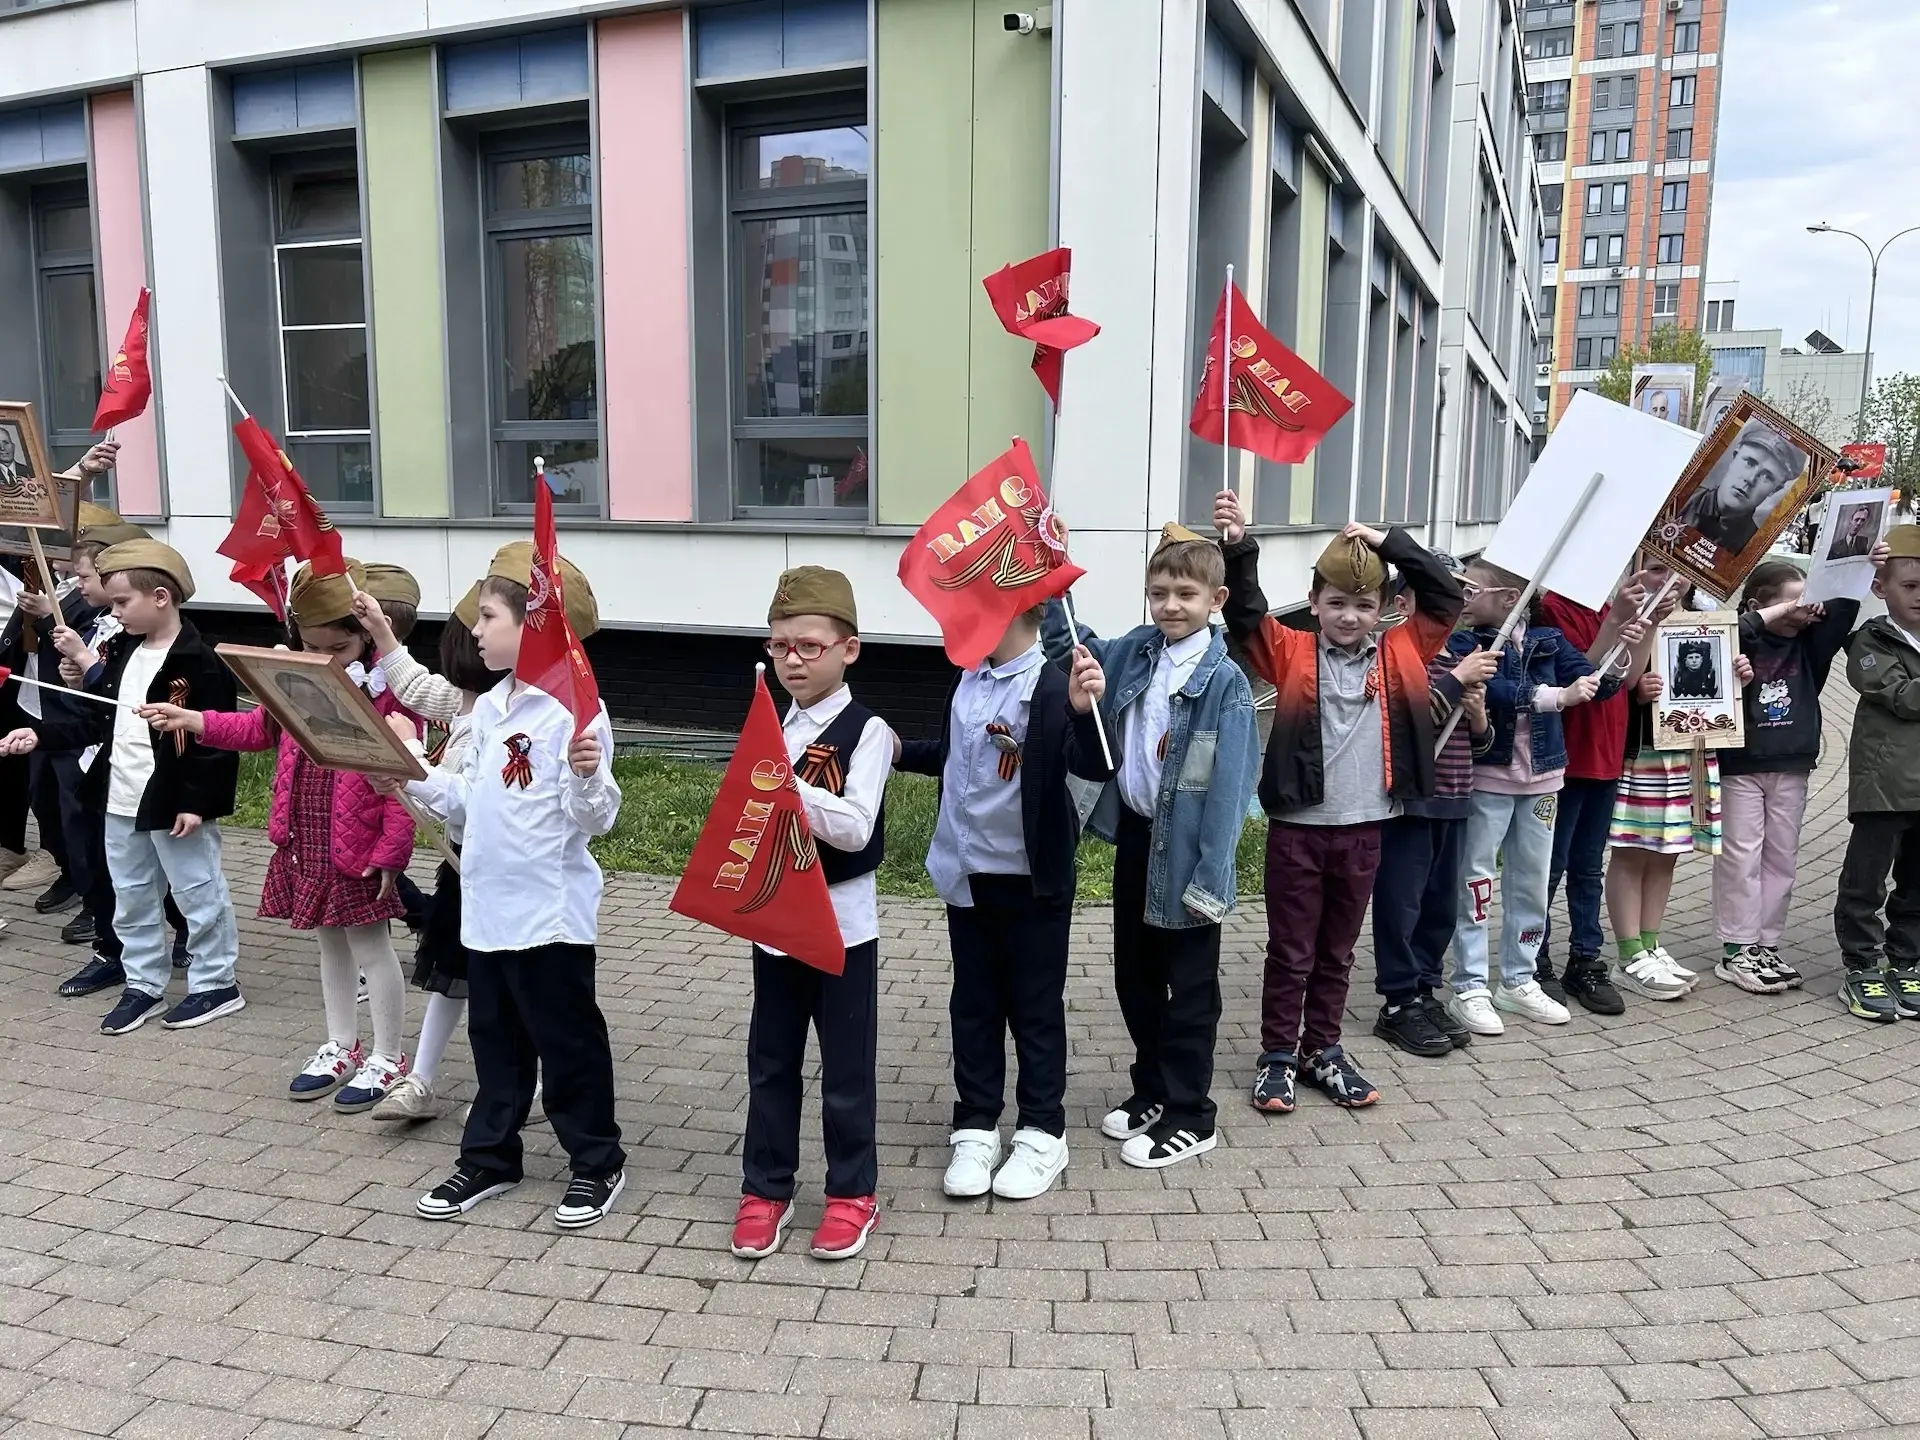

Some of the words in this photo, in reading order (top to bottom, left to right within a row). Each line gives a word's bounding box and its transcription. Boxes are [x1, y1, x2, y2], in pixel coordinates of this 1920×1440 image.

[1247, 358, 1312, 414] МАЯ
[1692, 543, 1714, 559] Андрей
[1698, 537, 1718, 552] ЗОТОВ
[1466, 877, 1493, 924] P
